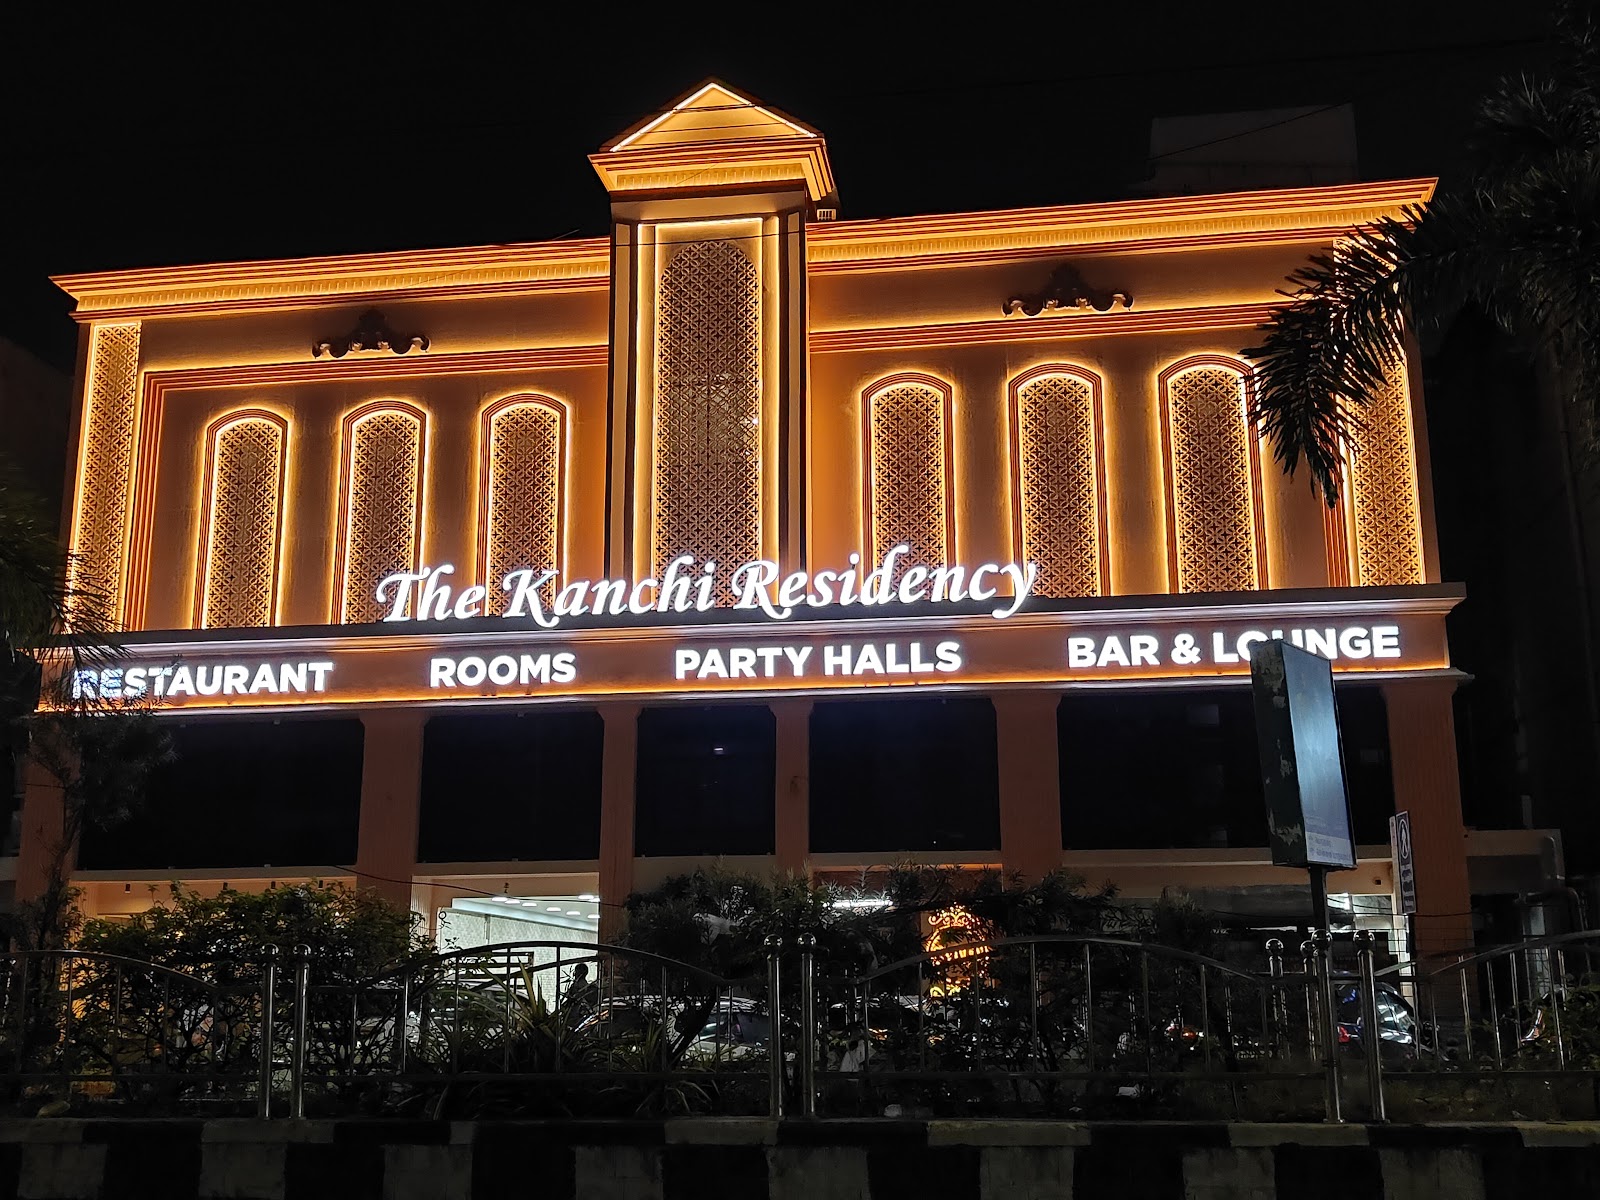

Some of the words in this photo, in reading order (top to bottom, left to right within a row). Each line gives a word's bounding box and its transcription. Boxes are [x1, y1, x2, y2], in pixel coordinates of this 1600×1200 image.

[376, 564, 487, 623] The
[502, 556, 716, 628] Kanchi
[731, 546, 1038, 619] Residency
[675, 647, 813, 680] PARTY
[824, 641, 962, 676] HALLS
[1068, 635, 1160, 668] BAR
[1171, 633, 1202, 664] &
[73, 662, 333, 699] RESTAURANT
[430, 653, 577, 688] ROOMS
